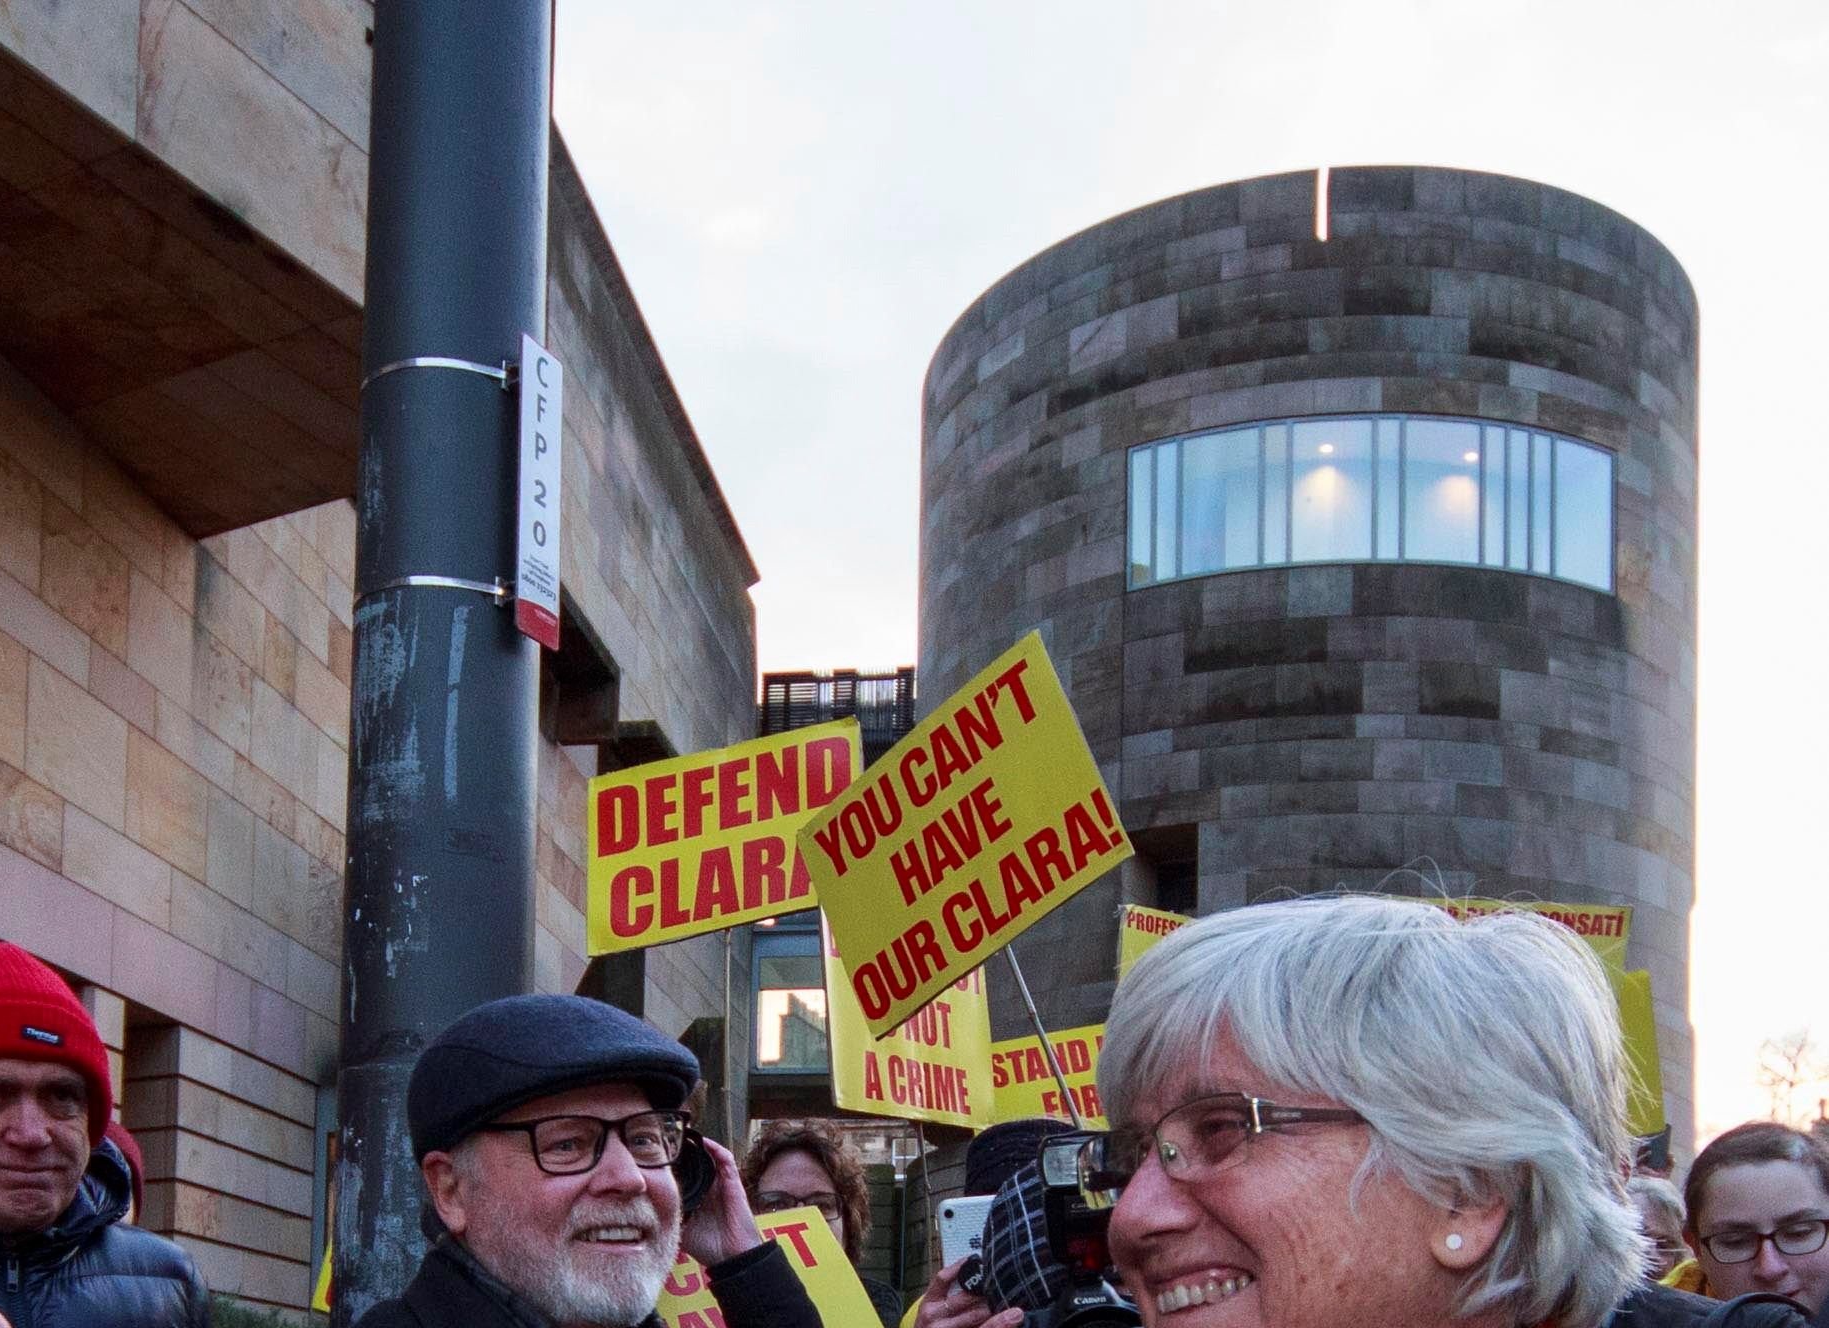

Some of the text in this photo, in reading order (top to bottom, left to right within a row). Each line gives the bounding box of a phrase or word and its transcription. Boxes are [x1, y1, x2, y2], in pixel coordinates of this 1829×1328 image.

[597, 736, 853, 858] DEFEND
[814, 658, 1037, 878] YOU CAN'T
[890, 777, 1013, 906] HAVE
[852, 787, 1124, 1021] OUR CLARA!
[865, 1051, 972, 1115] A CRIME
[991, 1039, 1091, 1088] STAND
[1073, 1296, 1107, 1305] Canon
